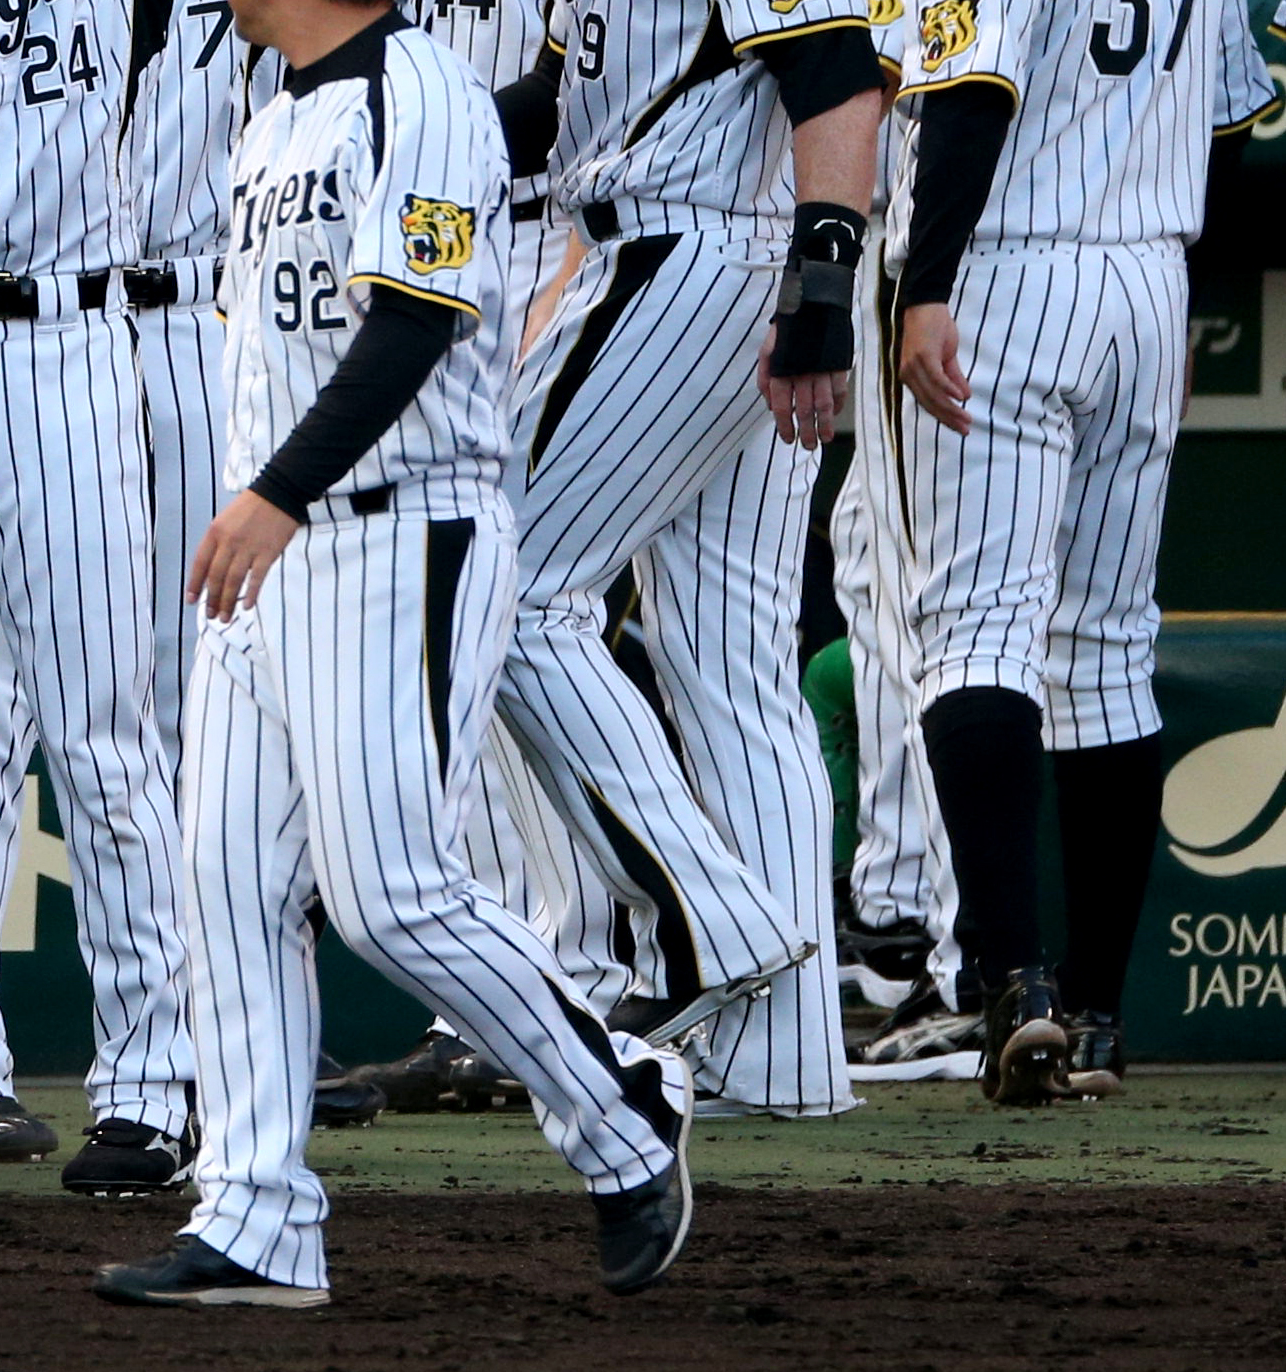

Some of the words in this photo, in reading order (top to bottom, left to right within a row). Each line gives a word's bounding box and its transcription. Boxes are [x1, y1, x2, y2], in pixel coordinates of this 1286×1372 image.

[20, 22, 99, 107] 24
[577, 11, 607, 82] 9
[273, 260, 349, 333] 92
[1168, 912, 1286, 958] SOM
